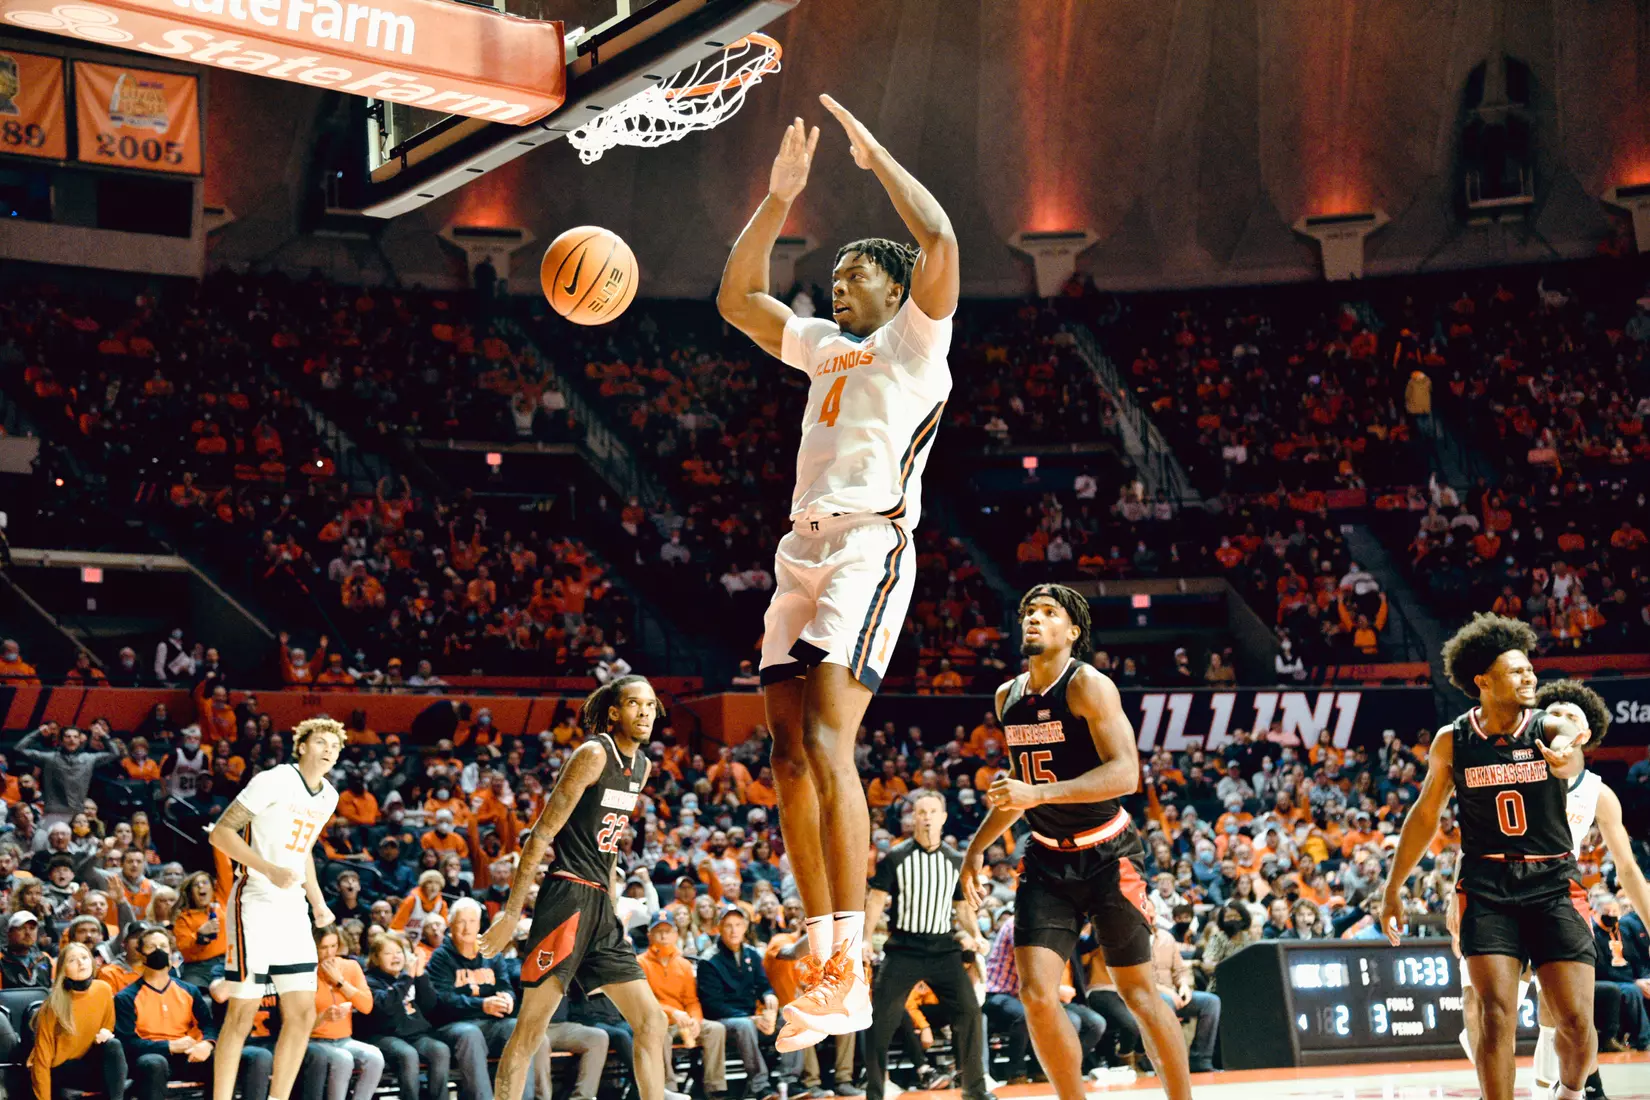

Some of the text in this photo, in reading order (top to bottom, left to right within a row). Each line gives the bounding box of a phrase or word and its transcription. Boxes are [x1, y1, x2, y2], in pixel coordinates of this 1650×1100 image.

[138, 29, 530, 120] State Farm
[96, 132, 185, 165] 2005
[587, 267, 624, 313] ELITE
[817, 375, 848, 428] 4
[1136, 692, 1362, 752] ILLINI
[1019, 750, 1058, 785] 15
[1495, 790, 1528, 836] 0
[285, 819, 316, 853] 33
[597, 812, 629, 854] 22
[1397, 956, 1450, 986] 17:33
[1335, 1004, 1350, 1035] 2
[1373, 1003, 1389, 1034] 3
